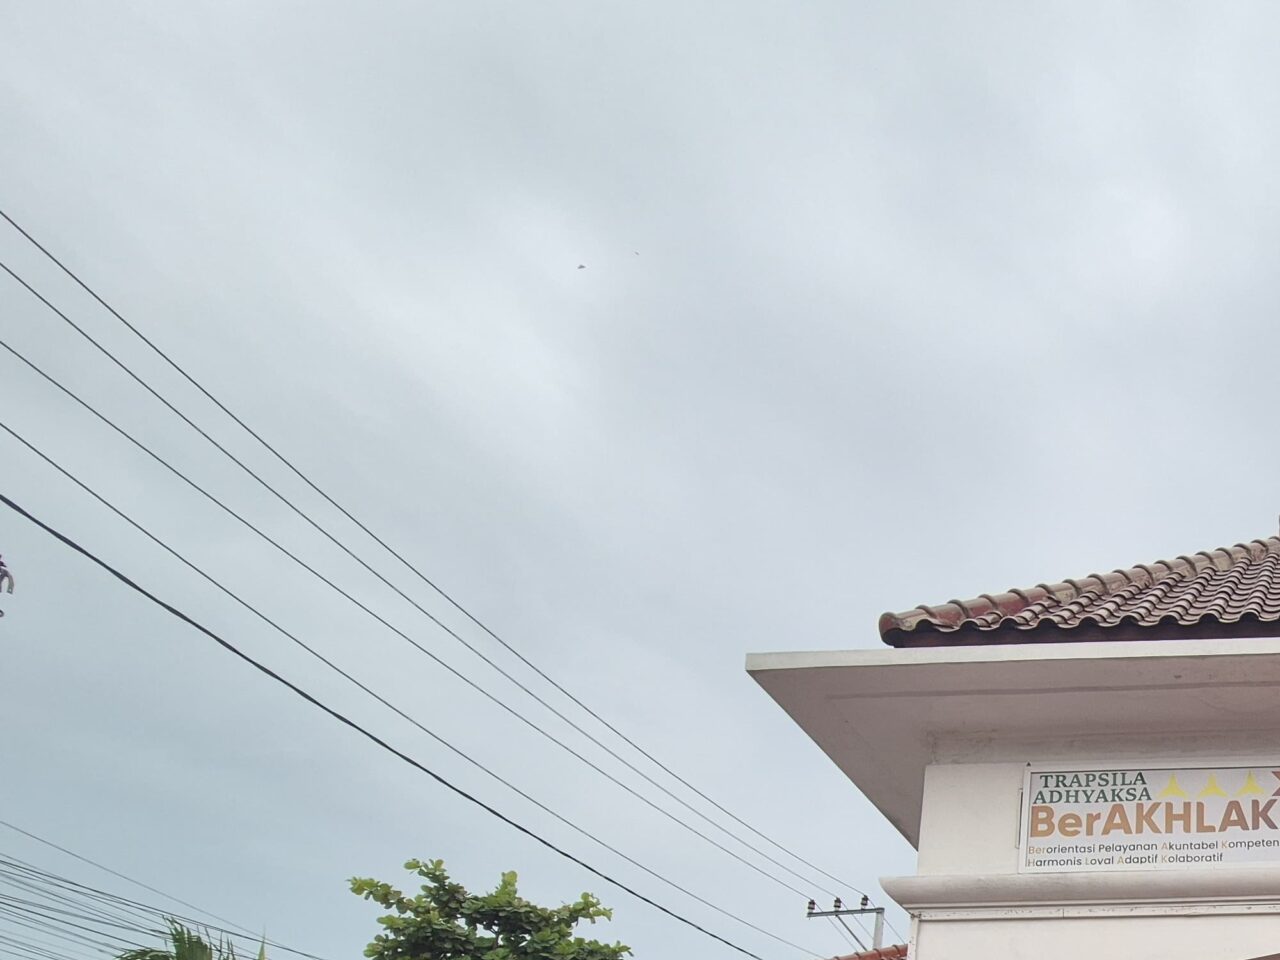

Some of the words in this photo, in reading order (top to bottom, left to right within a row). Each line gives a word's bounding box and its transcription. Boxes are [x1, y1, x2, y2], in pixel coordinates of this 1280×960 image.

[1039, 772, 1148, 788] TRAPSILA
[1033, 787, 1152, 804] ADHYAKSA
[1029, 799, 1279, 838] BerAKHLAK
[1028, 844, 1096, 855] Berorientasi
[1098, 842, 1158, 854] Pelayanan
[1161, 840, 1219, 851] Akuntabel
[1221, 838, 1280, 850] Kompeten
[1027, 857, 1082, 868] Harmonis
[1117, 854, 1158, 865] Adaptif
[1161, 853, 1223, 864] Kolaboratif
